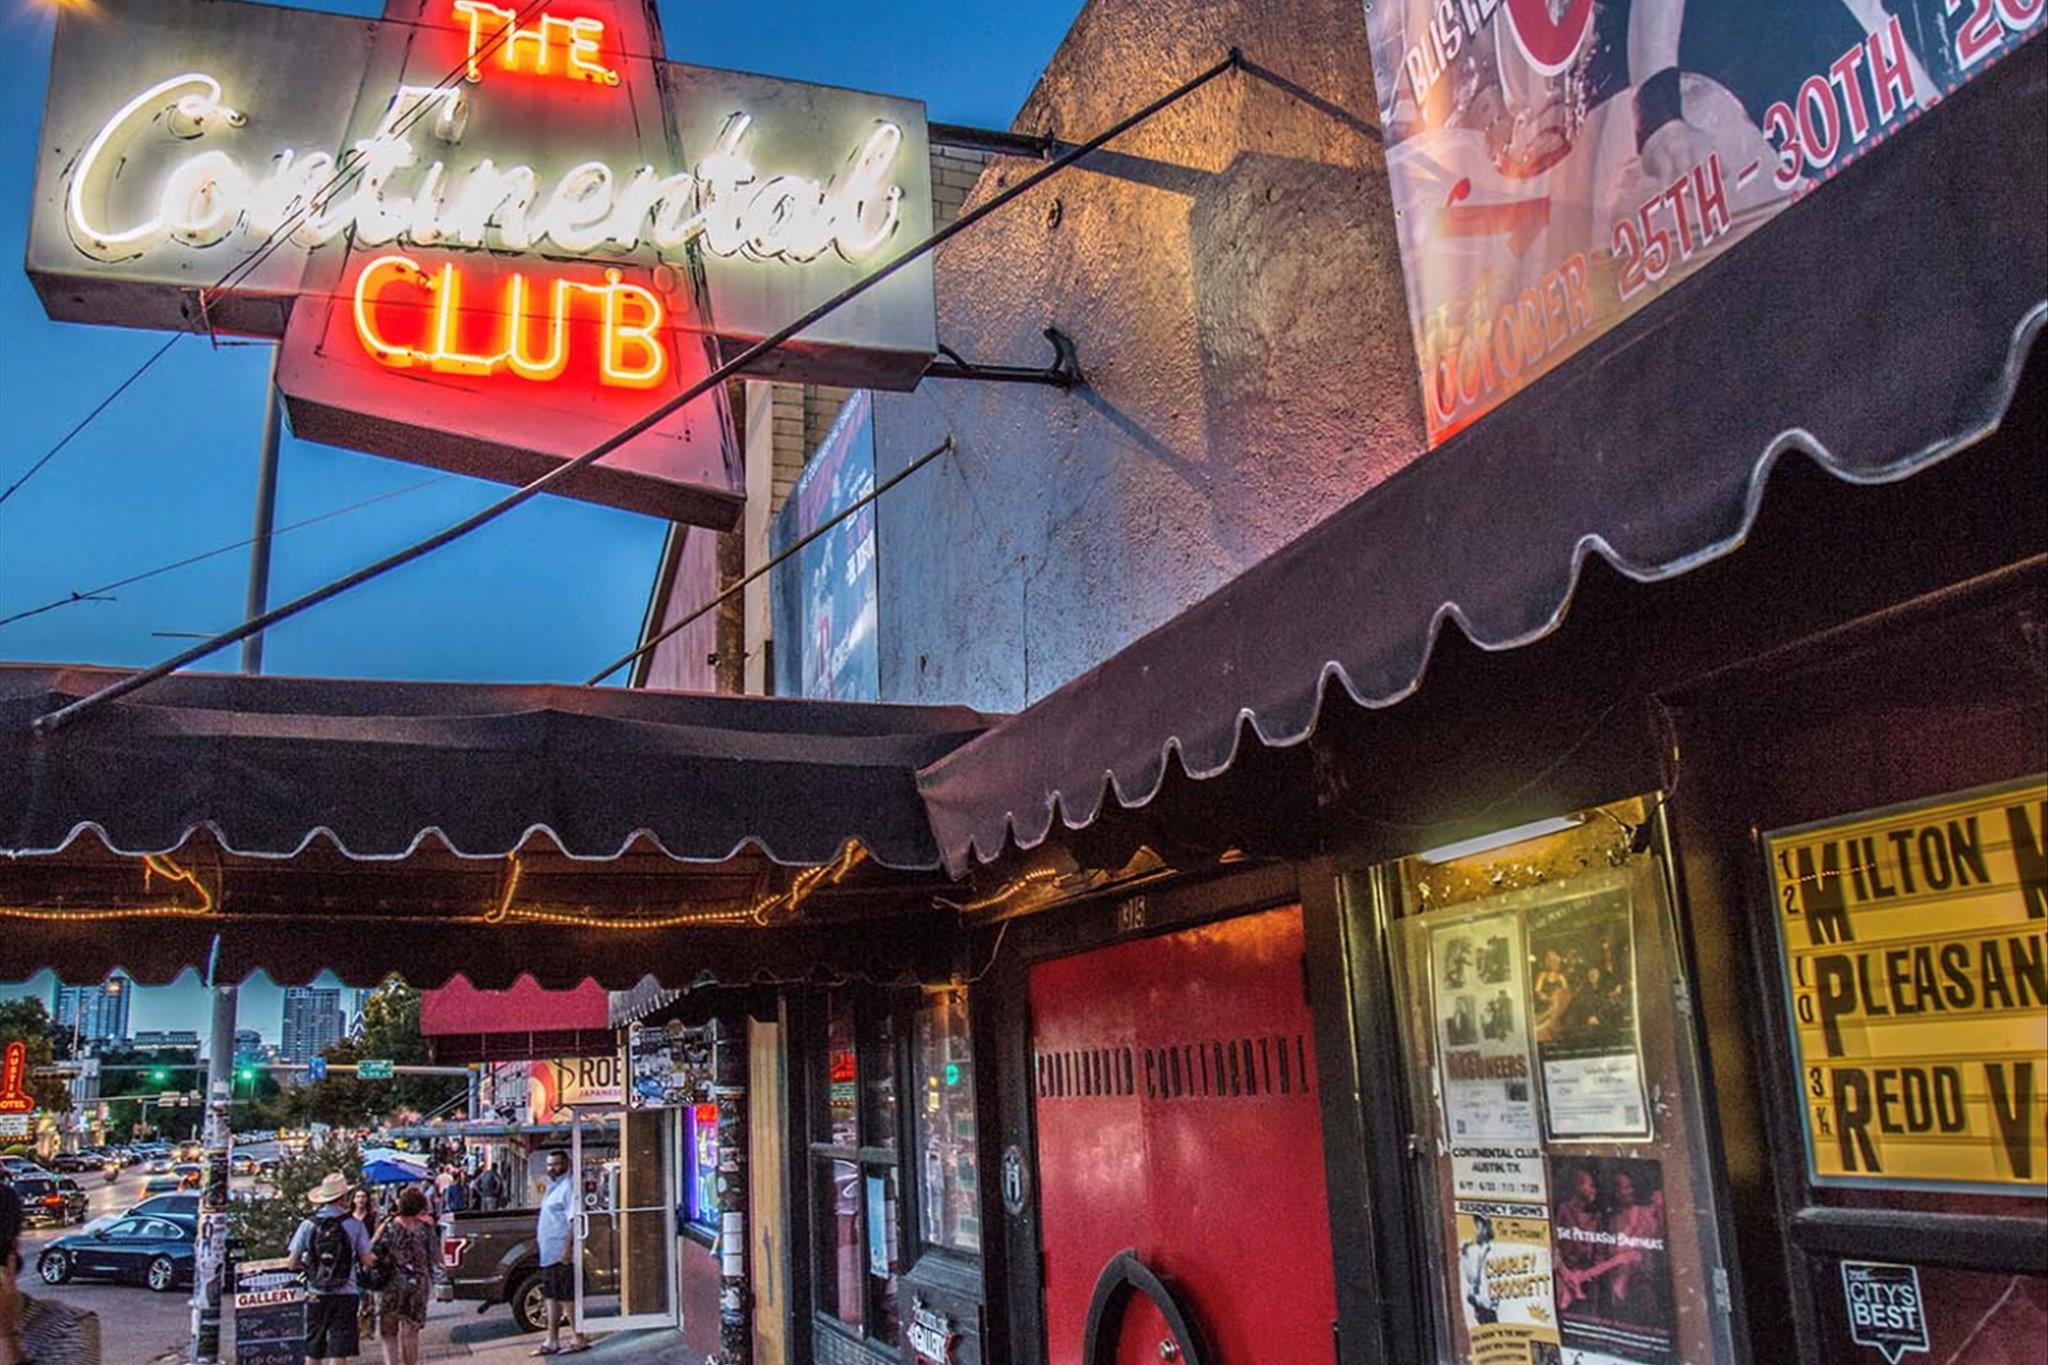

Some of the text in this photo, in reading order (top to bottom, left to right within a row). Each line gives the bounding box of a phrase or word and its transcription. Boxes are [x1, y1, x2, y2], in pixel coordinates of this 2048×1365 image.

[454, 0, 620, 86] THE
[66, 72, 905, 264] Continental
[1430, 249, 1591, 424] OCTOBER
[1611, 152, 1733, 302] 25TH
[1763, 15, 1917, 192] 30TH
[354, 256, 667, 388] CLUB
[1797, 816, 1991, 945] MILTON
[1814, 934, 2048, 1058] PLEASAN
[1453, 1147, 1540, 1159] CONTINENTAL CLUB
[1831, 1066, 1966, 1173] REDD
[1509, 1205, 1545, 1217] SHOWS
[238, 1289, 297, 1306] GALLERY
[1854, 1303, 1916, 1330] BEST
